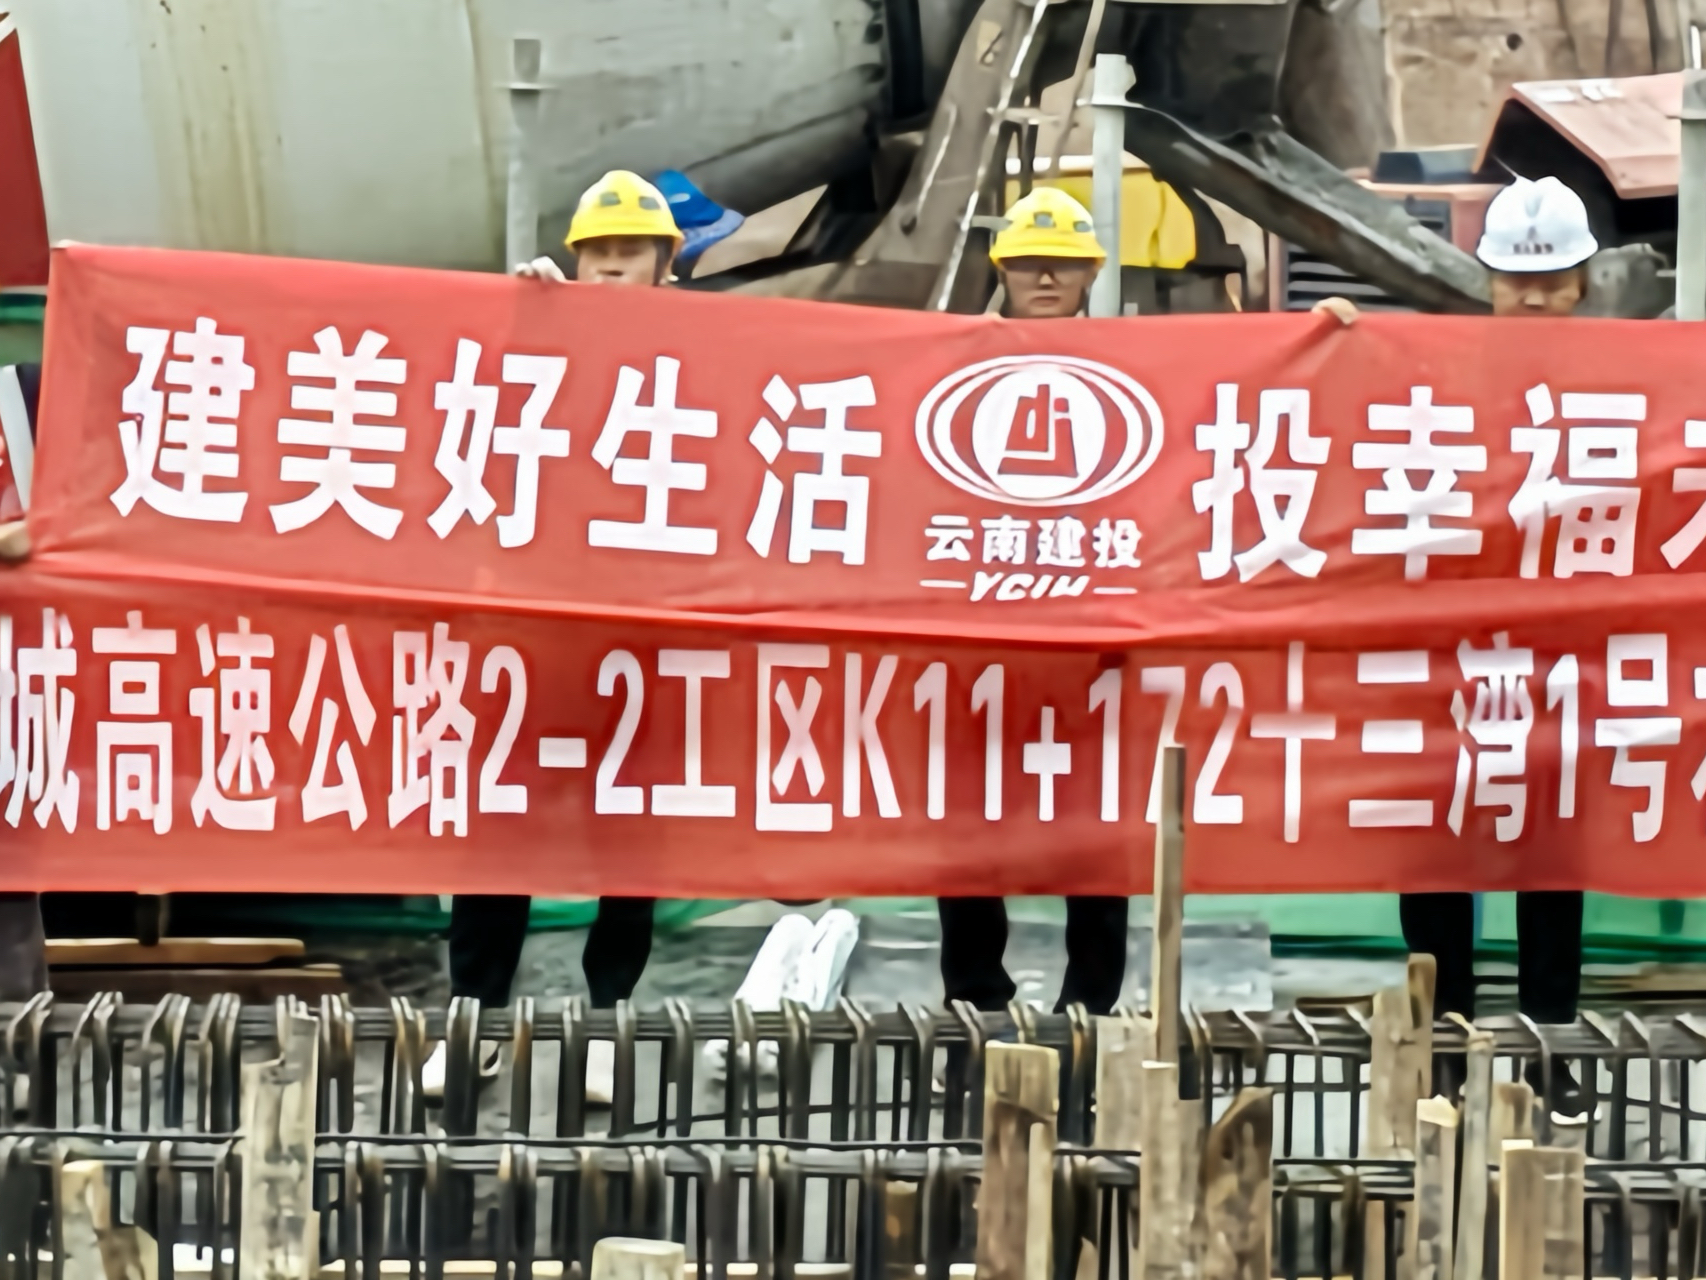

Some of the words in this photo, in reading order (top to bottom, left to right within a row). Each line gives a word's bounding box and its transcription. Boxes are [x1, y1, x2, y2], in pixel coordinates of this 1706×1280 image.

[109, 316, 882, 566] 建美好生活
[924, 515, 1143, 568] 云南建投
